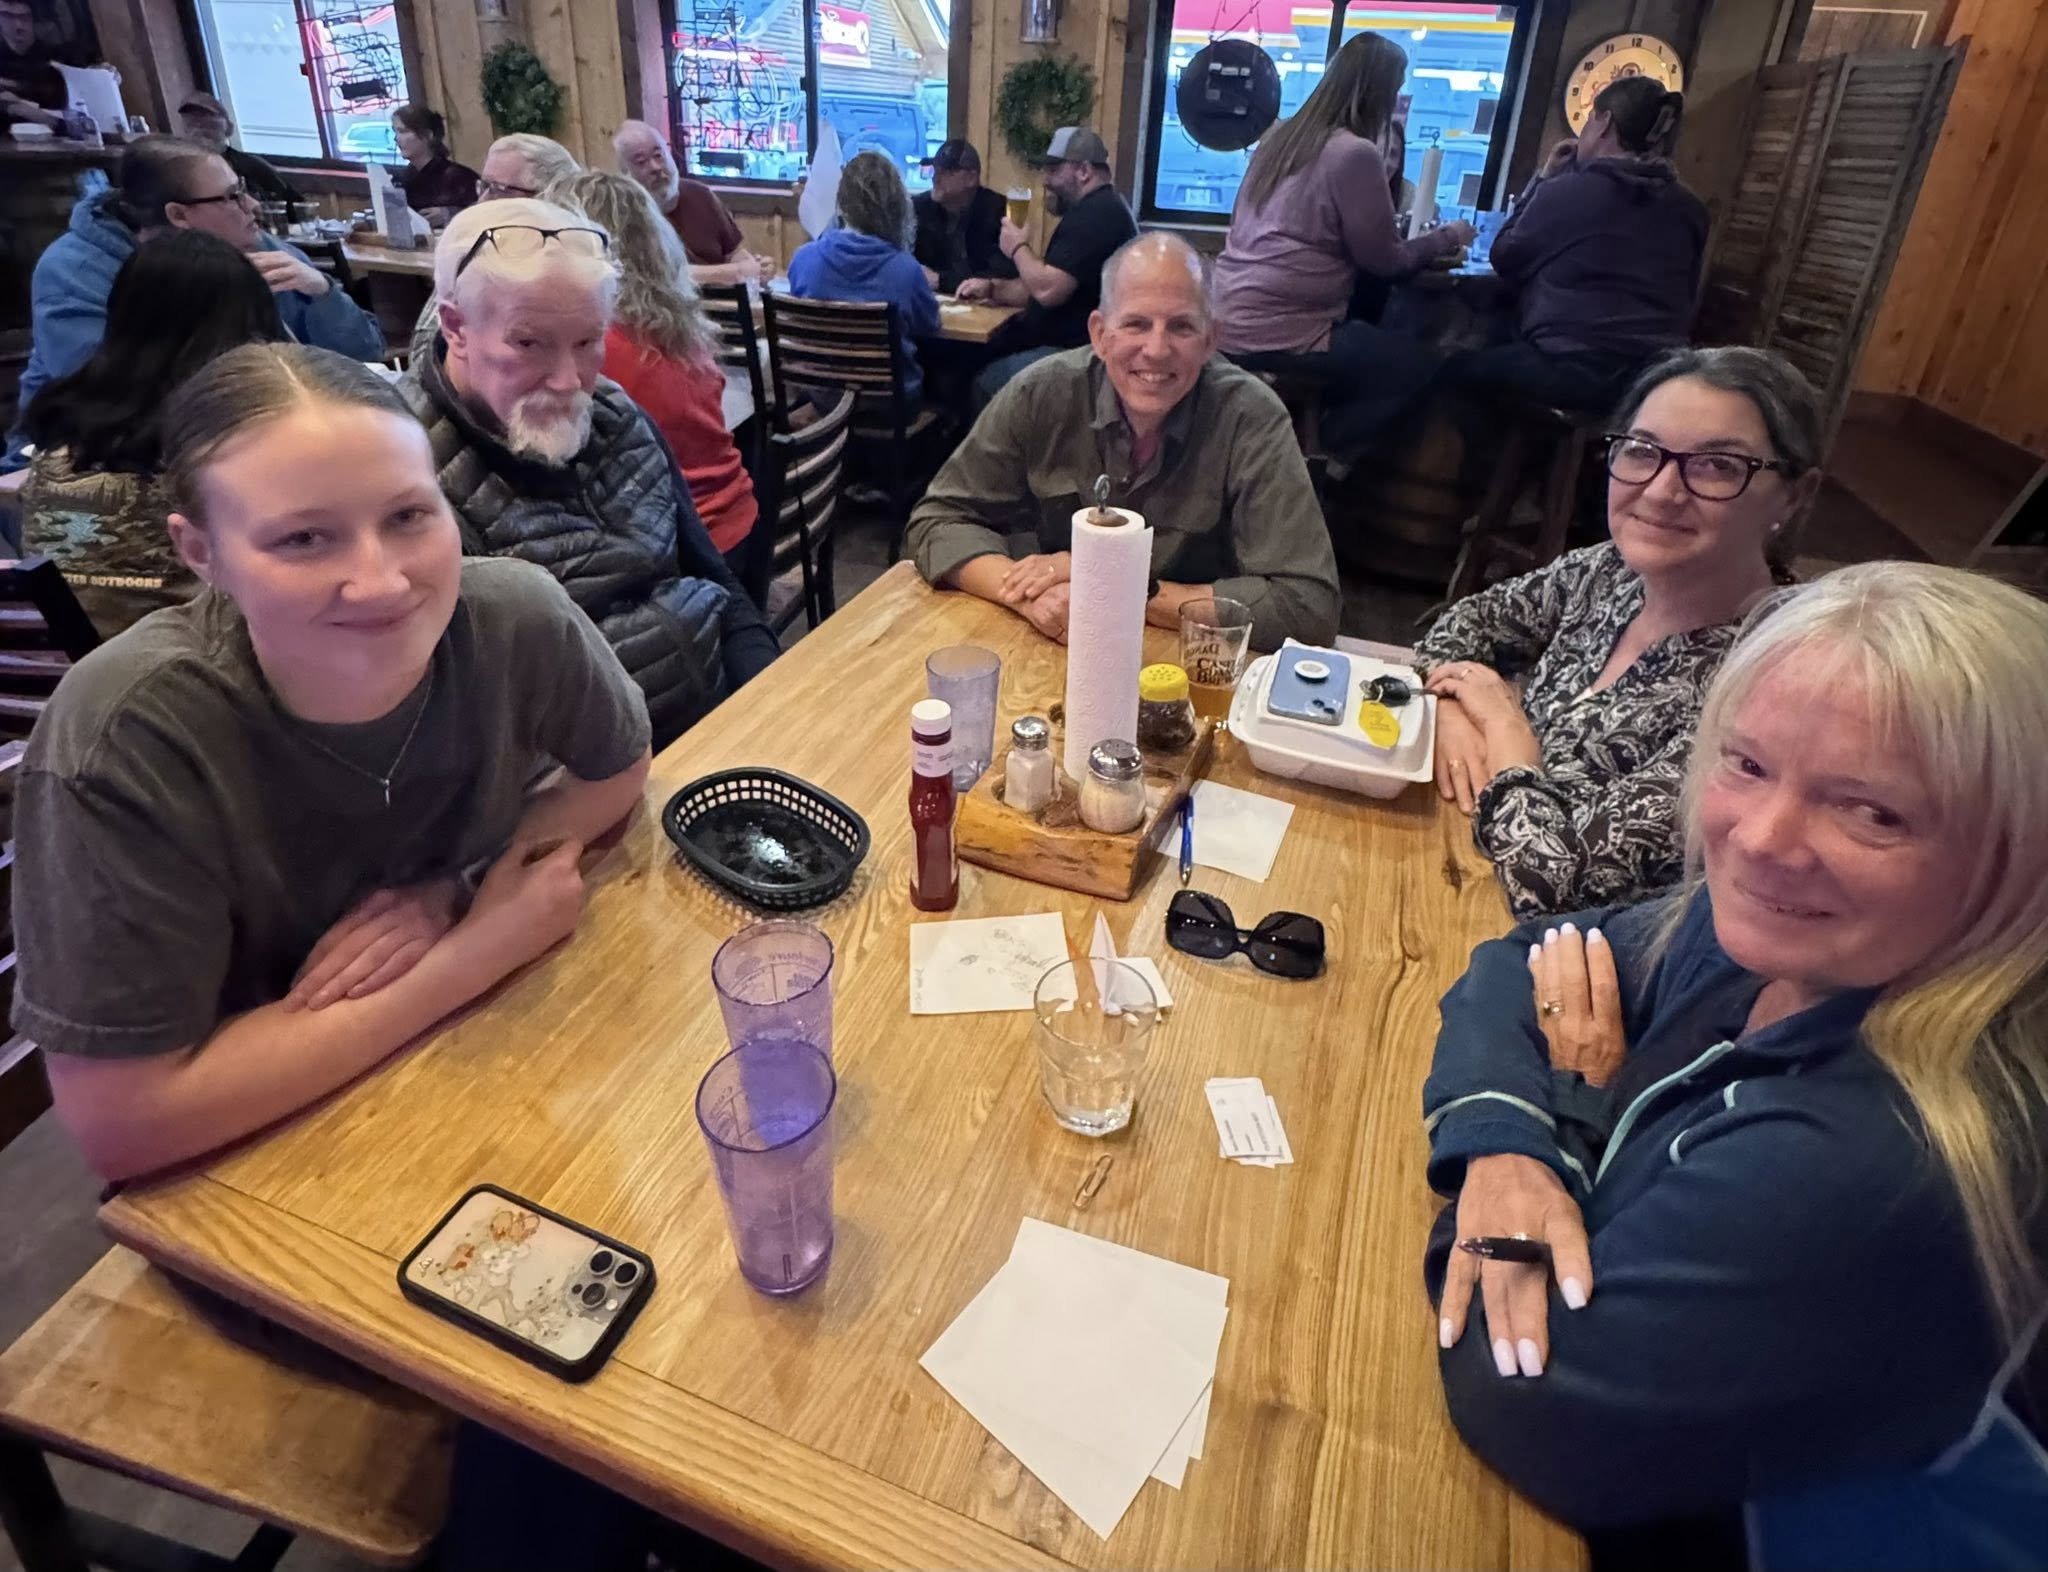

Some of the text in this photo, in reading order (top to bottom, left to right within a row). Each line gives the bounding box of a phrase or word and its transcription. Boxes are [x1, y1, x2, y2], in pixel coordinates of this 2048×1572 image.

[1631, 38, 1643, 48] 12
[1605, 44, 1615, 54] 11
[1583, 61, 1595, 72] 10
[1670, 63, 1678, 74] 2
[1571, 87, 1580, 97] 9
[63, 573, 162, 588] TER OUTDOORS
